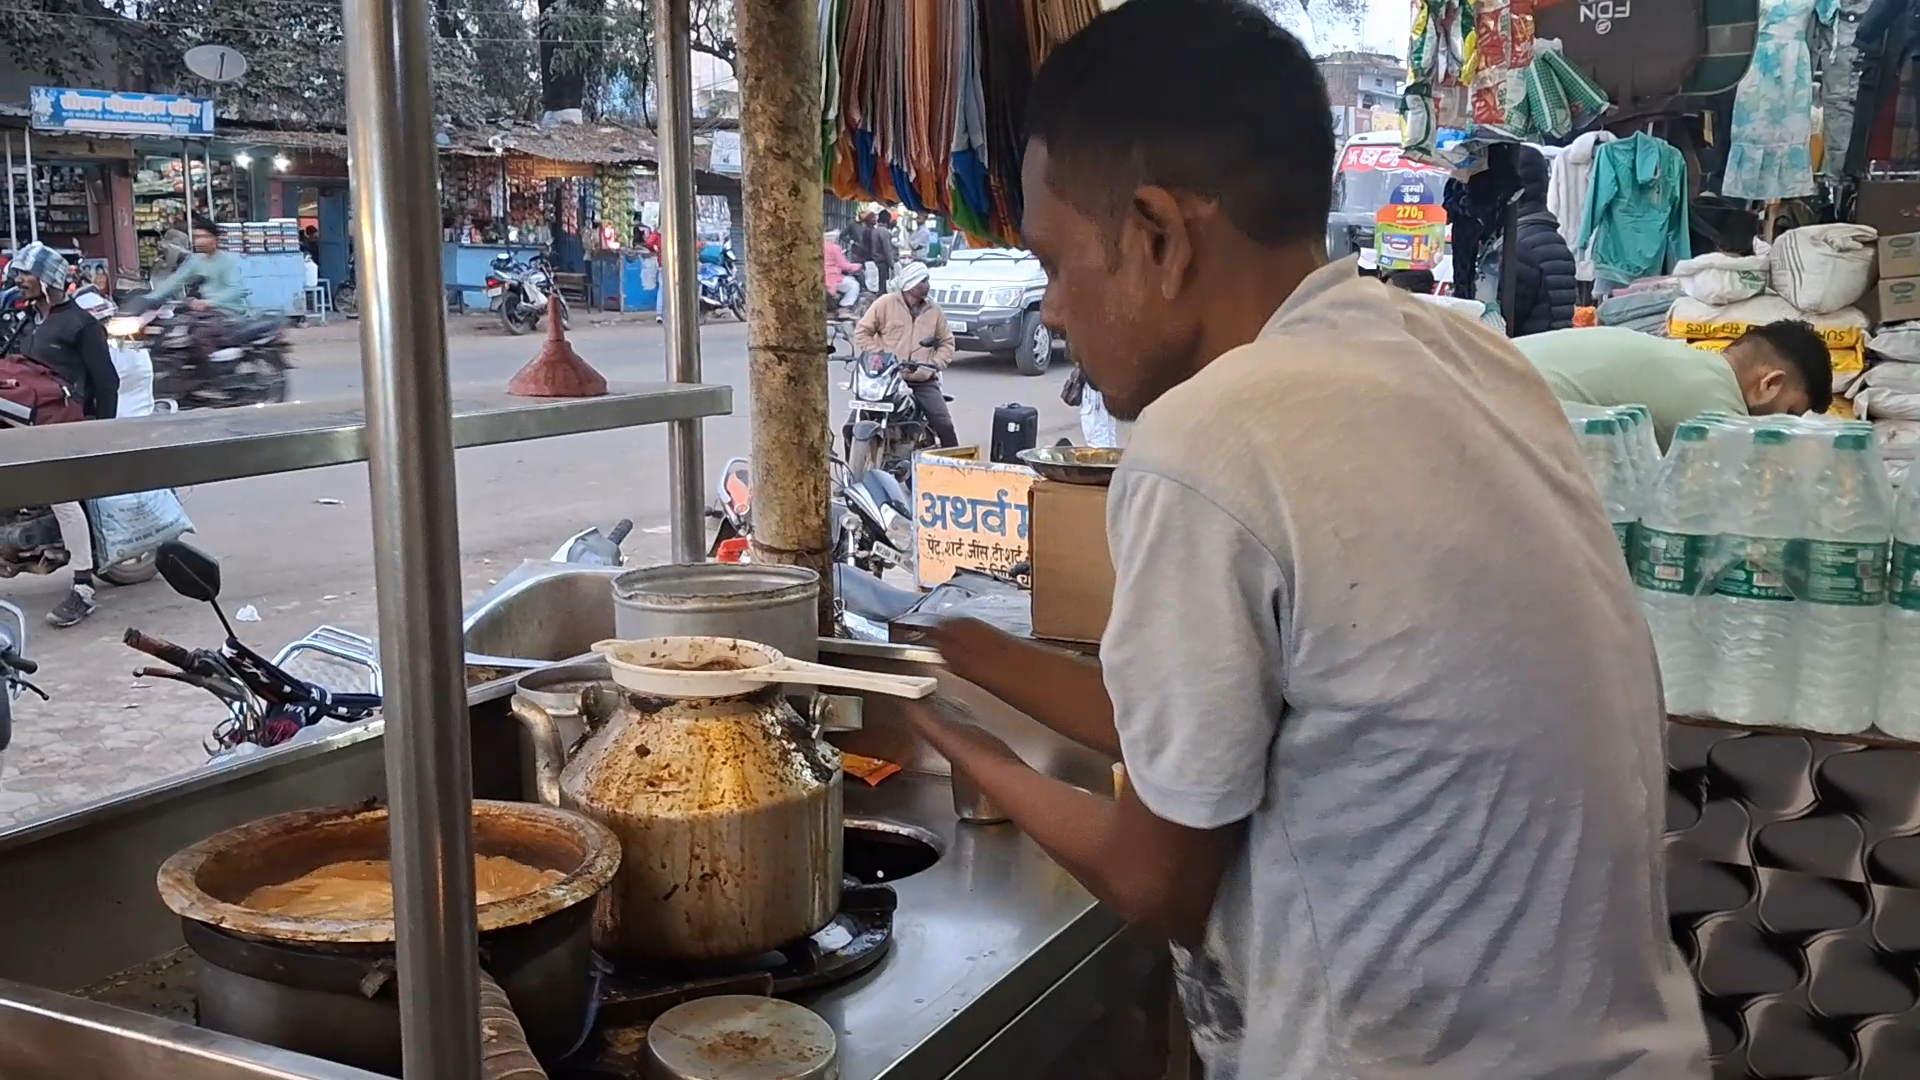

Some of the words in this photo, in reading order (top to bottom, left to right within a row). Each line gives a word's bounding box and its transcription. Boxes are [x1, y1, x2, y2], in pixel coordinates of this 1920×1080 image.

[1580, 0, 1630, 23] FDN
[1404, 193, 1420, 203] केक
[1396, 206, 1423, 219] 270g
[920, 489, 1011, 537] अथर्व
